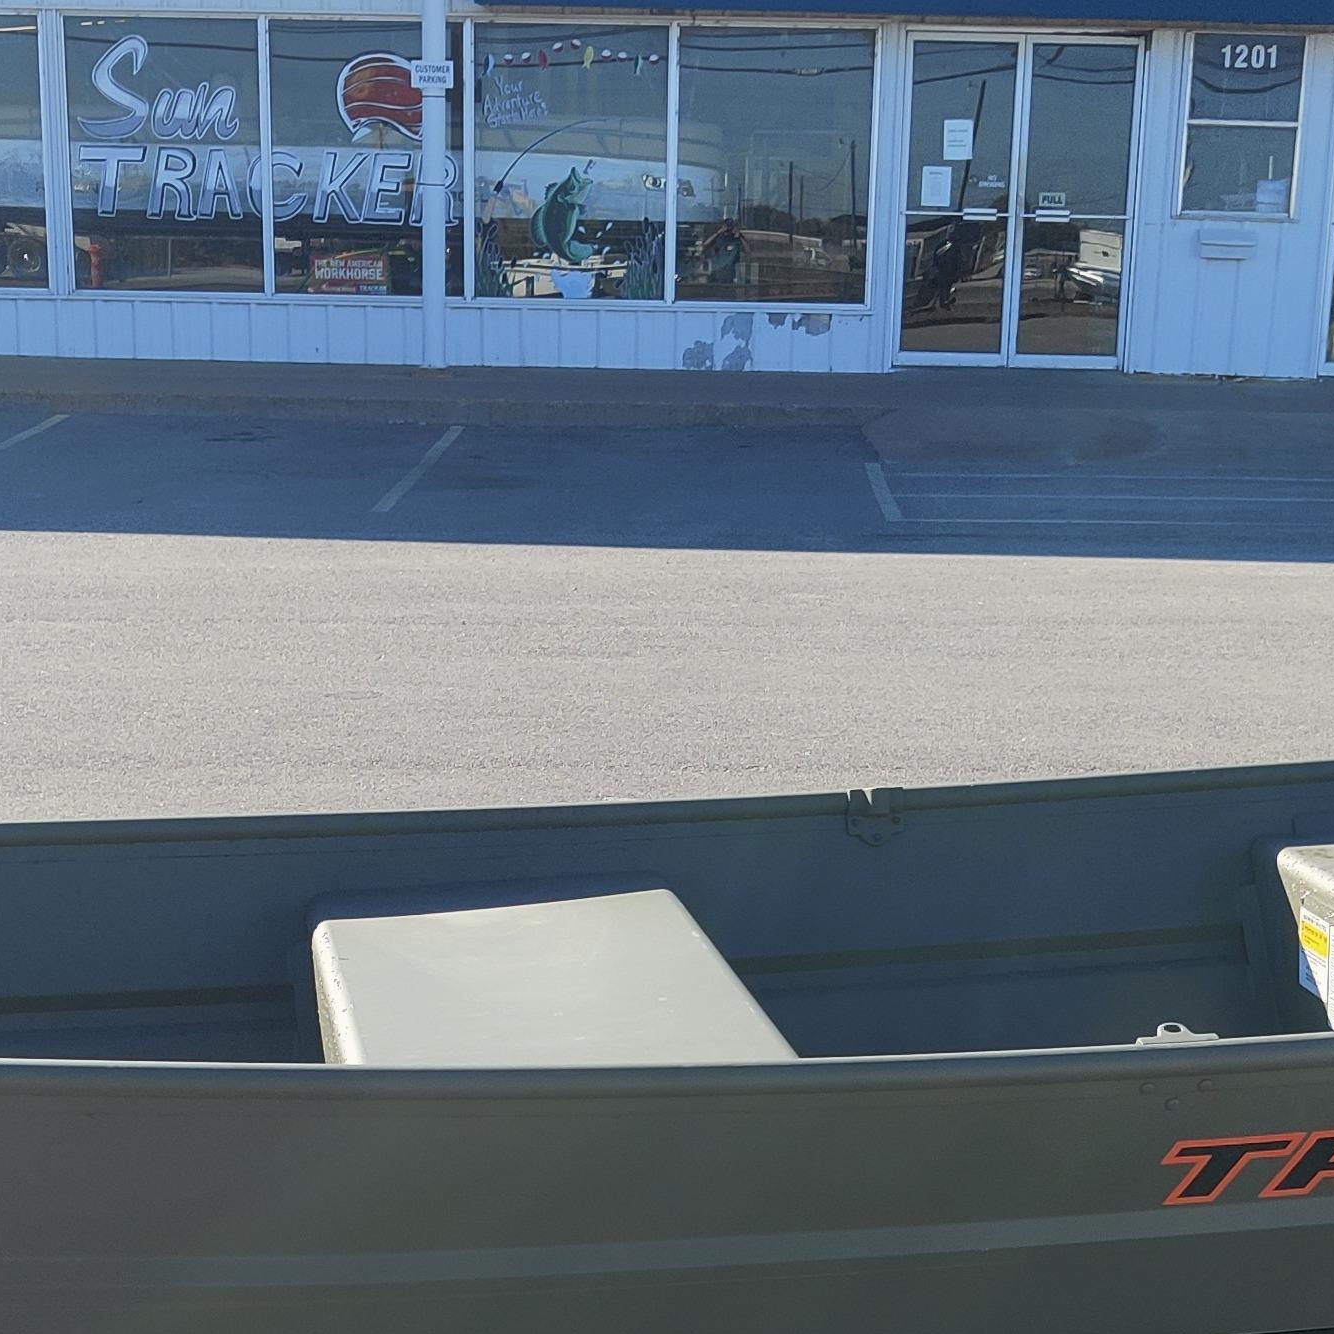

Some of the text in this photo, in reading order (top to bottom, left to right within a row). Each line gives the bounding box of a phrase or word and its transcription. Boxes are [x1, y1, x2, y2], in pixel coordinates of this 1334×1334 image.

[1220, 44, 1278, 69] 1201
[414, 64, 451, 74] CUSTOMER
[77, 33, 239, 141] Sun
[418, 75, 447, 84] PARKING
[77, 144, 460, 227] TRACKER
[314, 268, 384, 281] WORKHORSE
